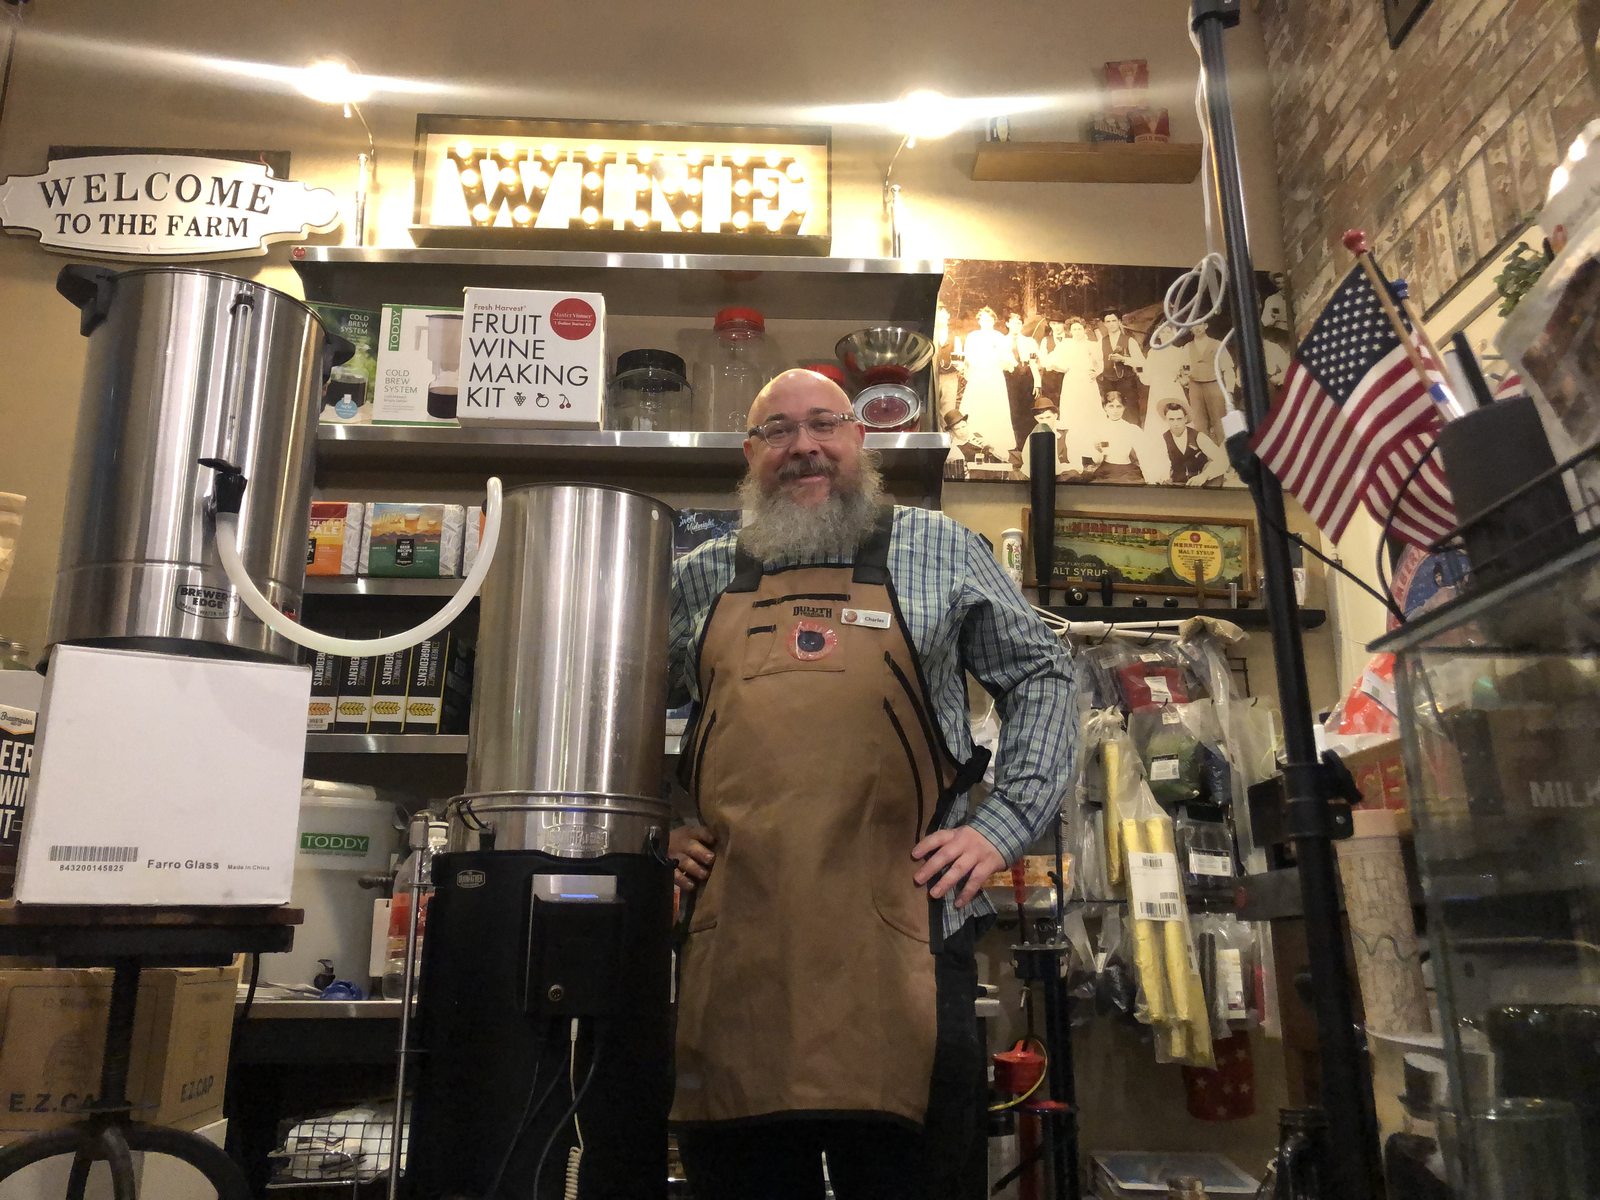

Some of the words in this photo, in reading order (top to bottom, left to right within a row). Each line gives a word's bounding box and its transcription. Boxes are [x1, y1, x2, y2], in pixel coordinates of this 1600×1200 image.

[37, 171, 274, 215] WELCOME
[446, 144, 810, 236] WINE
[55, 213, 91, 234] TO
[99, 213, 157, 236] THE
[166, 214, 249, 238] FARM
[473, 303, 493, 311] Fresh
[347, 320, 369, 328] BREW
[349, 313, 370, 322] COLD
[472, 313, 542, 335] FRUIT
[340, 326, 368, 335] SYSTEM
[389, 310, 401, 349] TODDY
[469, 338, 545, 360] WINE
[384, 377, 410, 385] BREW
[385, 369, 410, 377] COLD
[468, 362, 589, 387] MAKING
[383, 385, 418, 394] SYSTEM
[466, 387, 505, 408] KIT
[1052, 567, 1071, 576] ALT
[192, 597, 225, 609] EDGE
[864, 616, 885, 624] Charles
[313, 652, 326, 686] REDIENTS
[347, 656, 360, 686] EDIENTS
[381, 652, 395, 685] REDIENTS
[416, 640, 431, 687] INGREDIENTS
[304, 835, 367, 850] TODDY
[147, 859, 181, 869] Farro
[184, 859, 219, 870] Glass
[9, 1093, 99, 1113] E.Z.CA
